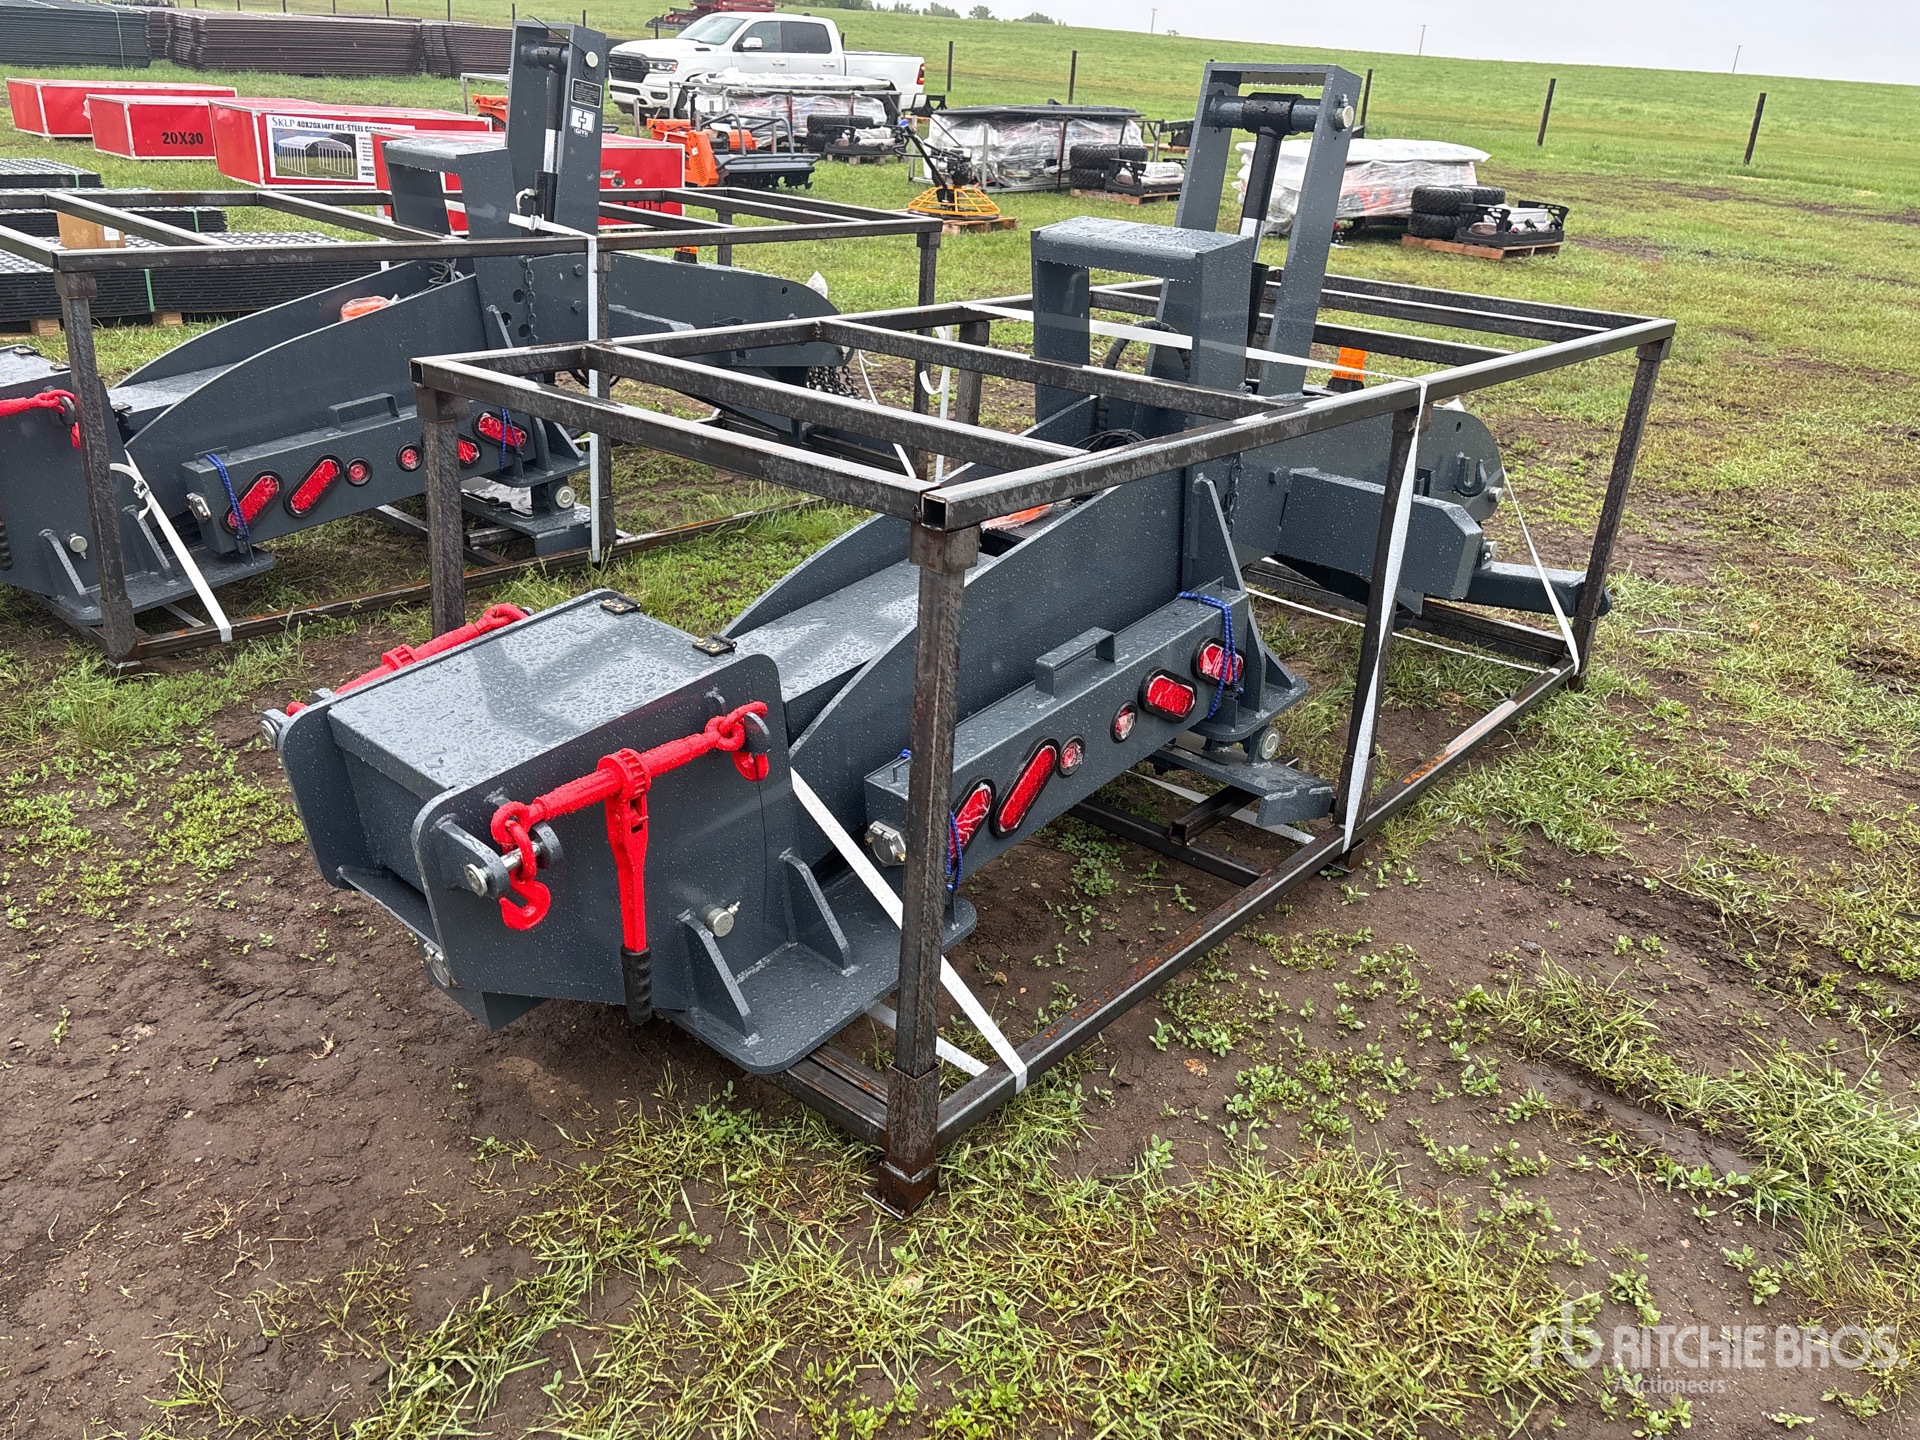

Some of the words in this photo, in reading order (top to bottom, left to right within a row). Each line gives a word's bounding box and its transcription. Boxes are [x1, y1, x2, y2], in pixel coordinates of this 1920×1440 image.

[272, 117, 296, 128] SKLP
[335, 123, 364, 133] ALL-STEEL
[162, 131, 204, 145] 20X30
